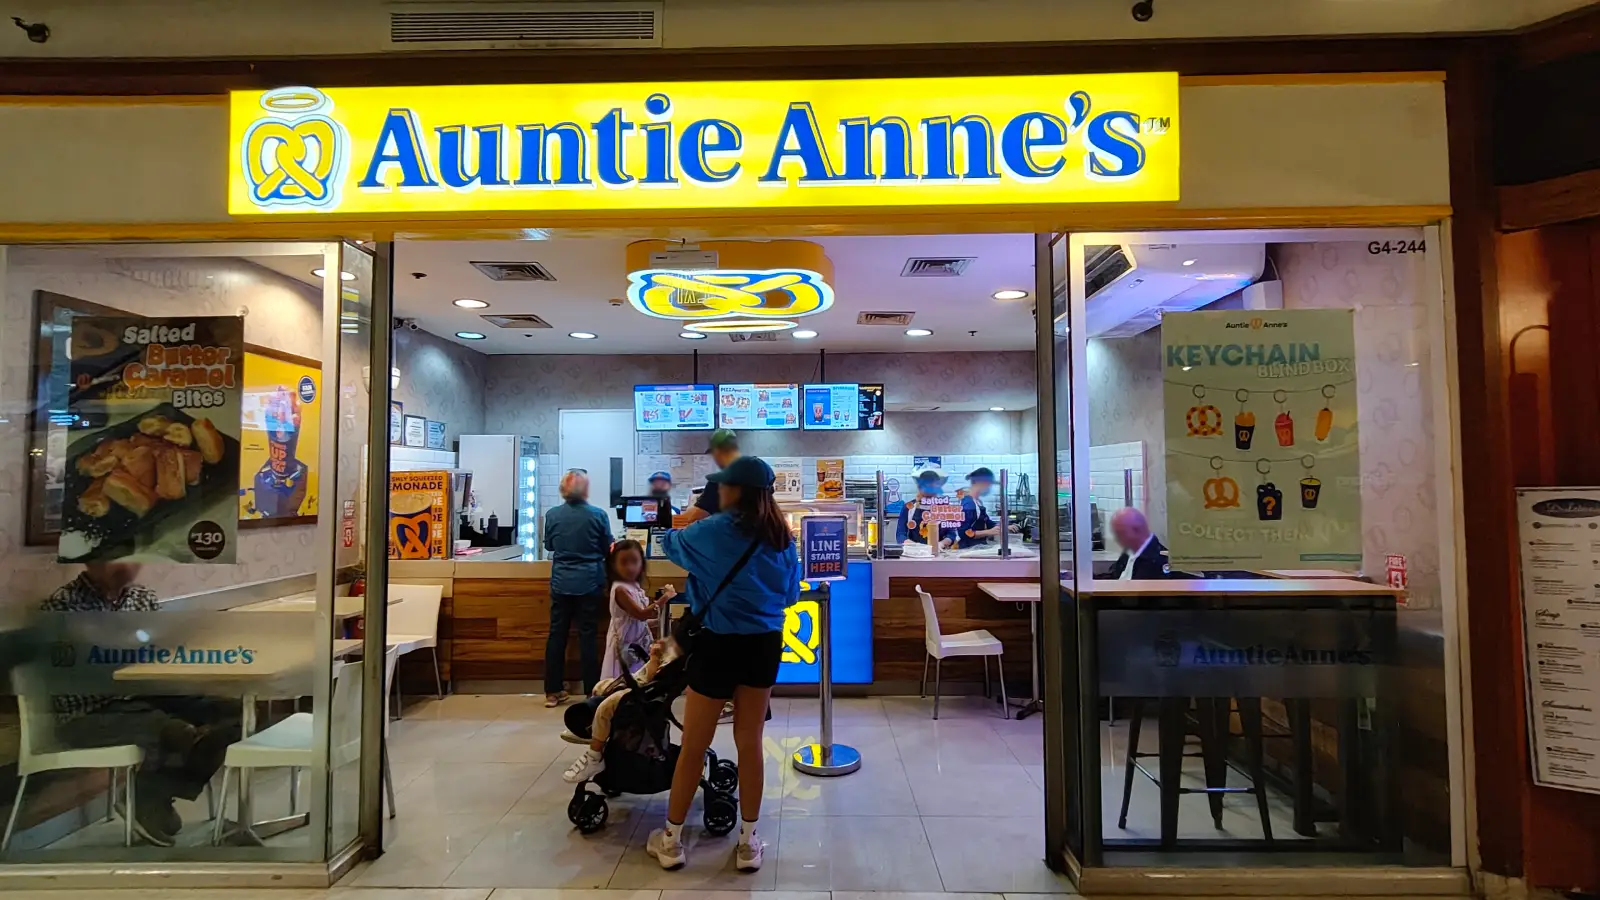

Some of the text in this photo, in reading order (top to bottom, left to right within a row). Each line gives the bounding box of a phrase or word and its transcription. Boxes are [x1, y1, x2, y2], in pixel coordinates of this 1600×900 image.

[357, 93, 742, 187] Auntie
[758, 90, 1146, 184] Anne's
[1368, 240, 1426, 255] G4-244
[1226, 320, 1288, 330] Auntie Anne's
[123, 323, 196, 345] Salted
[145, 344, 232, 367] Butter
[1166, 342, 1320, 367] KEYCHAIN
[122, 363, 236, 390] Caramel
[171, 391, 226, 409] Bites
[391, 481, 443, 491] MONADE
[921, 496, 949, 505] Salted
[811, 540, 841, 552] LINE
[811, 553, 841, 561] STARTS
[811, 562, 841, 573] HERE
